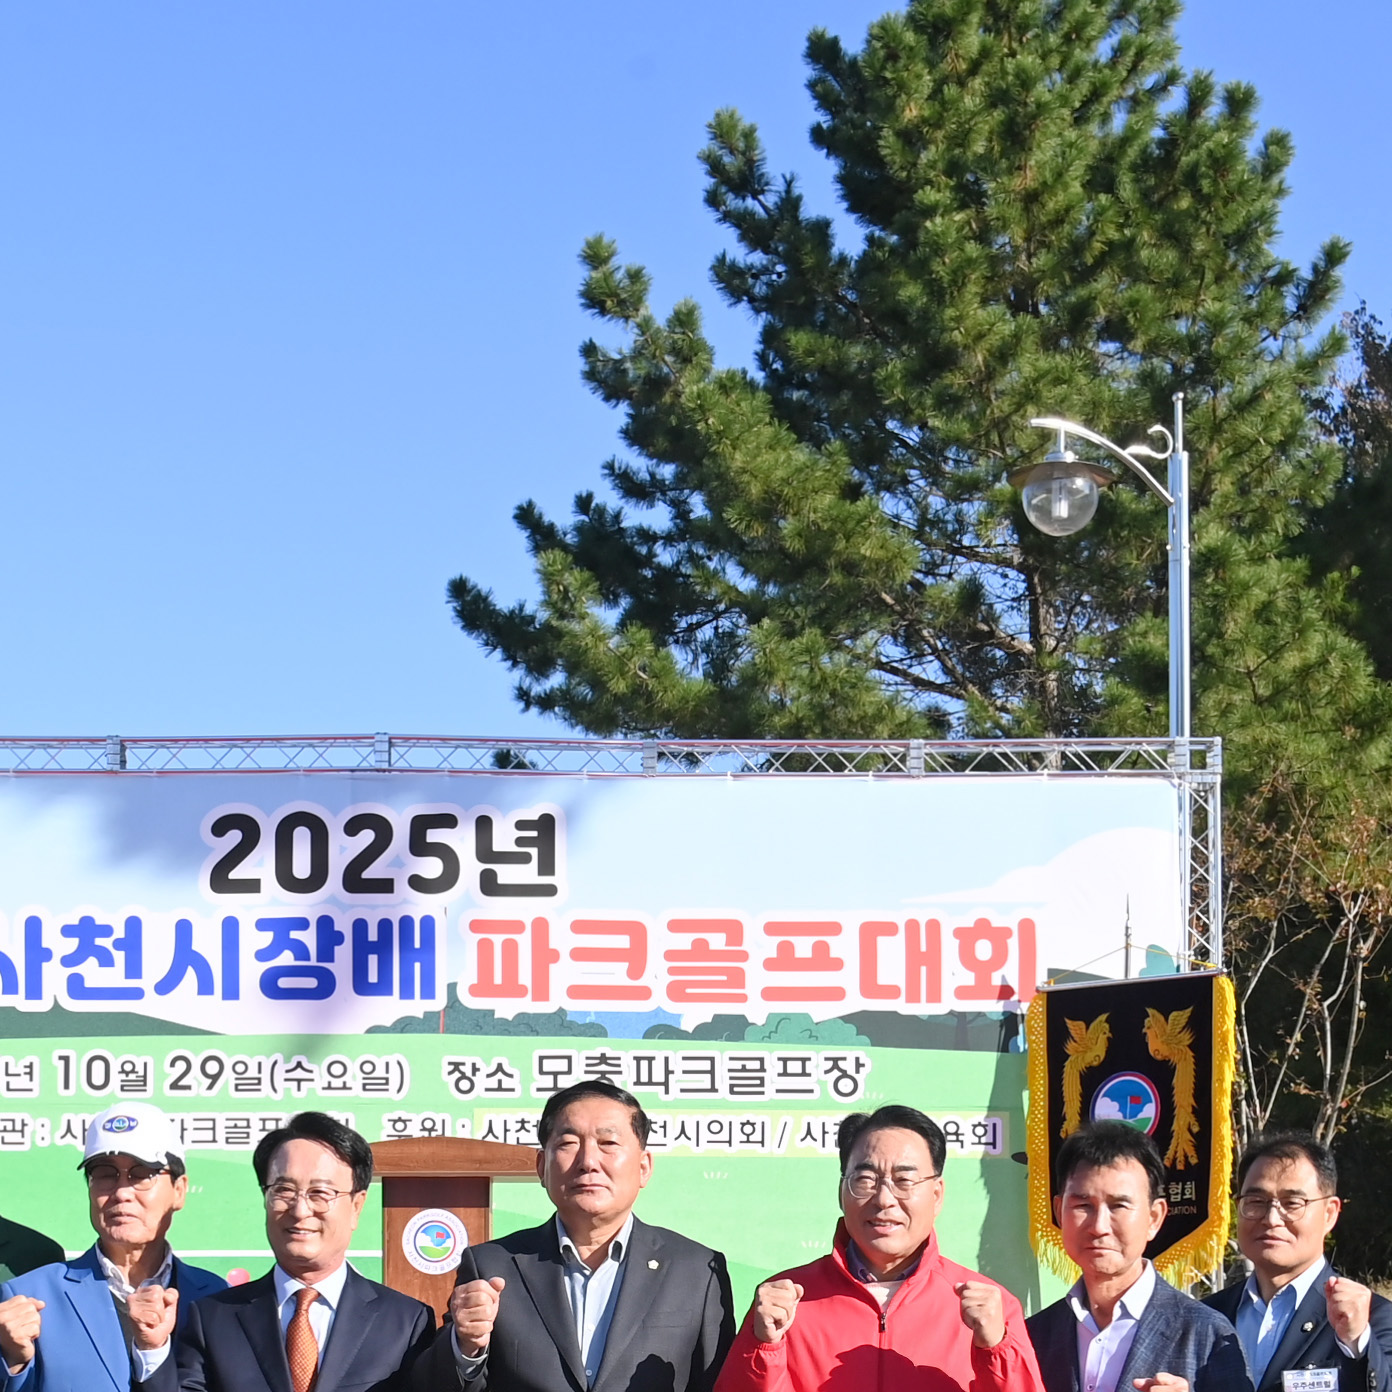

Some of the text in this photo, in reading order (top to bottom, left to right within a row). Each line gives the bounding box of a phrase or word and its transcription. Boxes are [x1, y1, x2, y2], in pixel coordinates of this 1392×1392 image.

[209, 810, 559, 898] 2025년
[468, 914, 1042, 1003] 파크골프대회
[54, 1054, 148, 1093] 10월
[169, 1055, 408, 1094] 29일(수요일)
[446, 1060, 516, 1096] 장소
